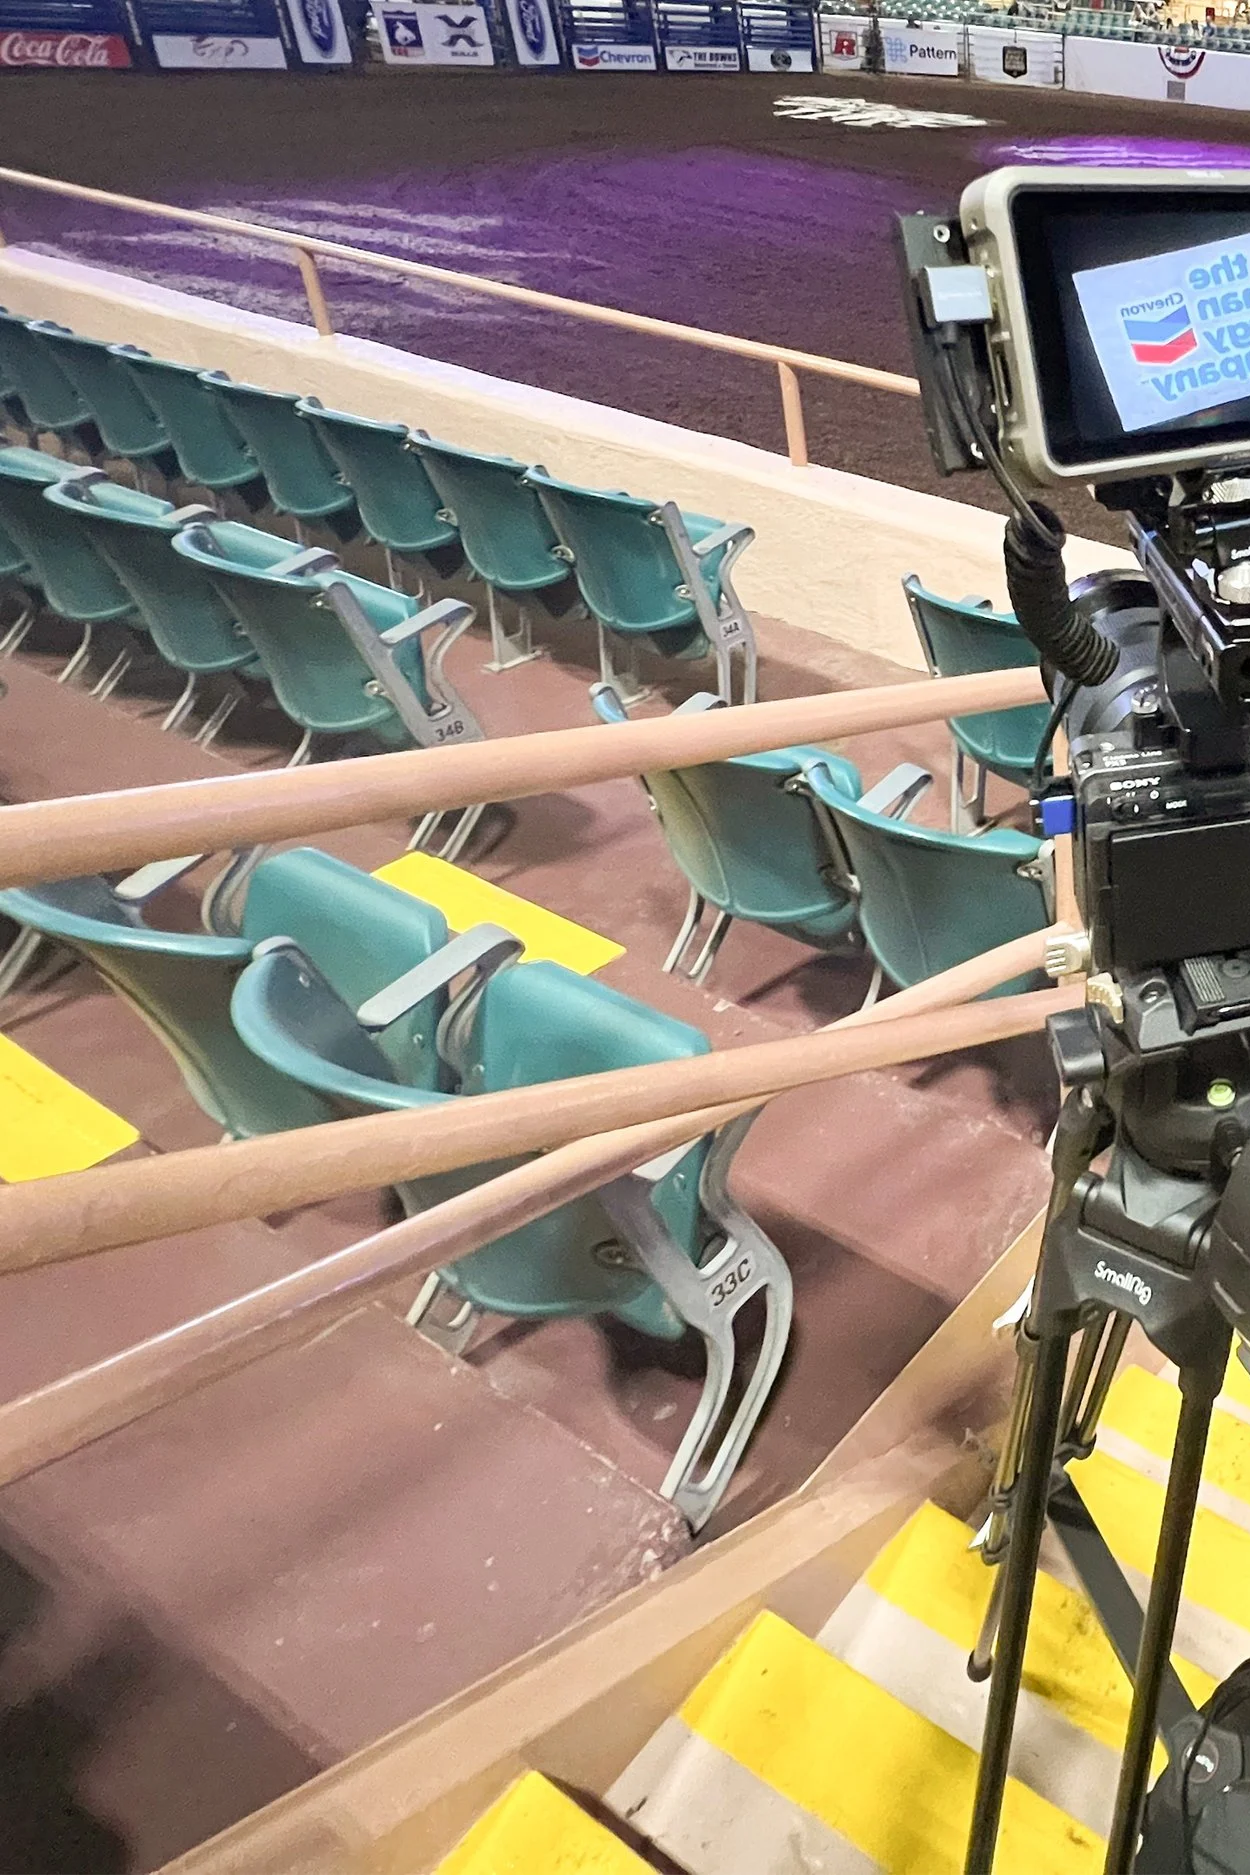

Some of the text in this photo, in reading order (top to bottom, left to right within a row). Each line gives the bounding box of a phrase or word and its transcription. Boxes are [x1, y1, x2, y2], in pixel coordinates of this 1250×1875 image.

[599, 50, 651, 64] Chevron
[909, 44, 957, 60] Pattern
[722, 622, 740, 638] 34A
[435, 720, 465, 742] 34B
[1109, 776, 1161, 792] SONY
[711, 1258, 751, 1307] 33C
